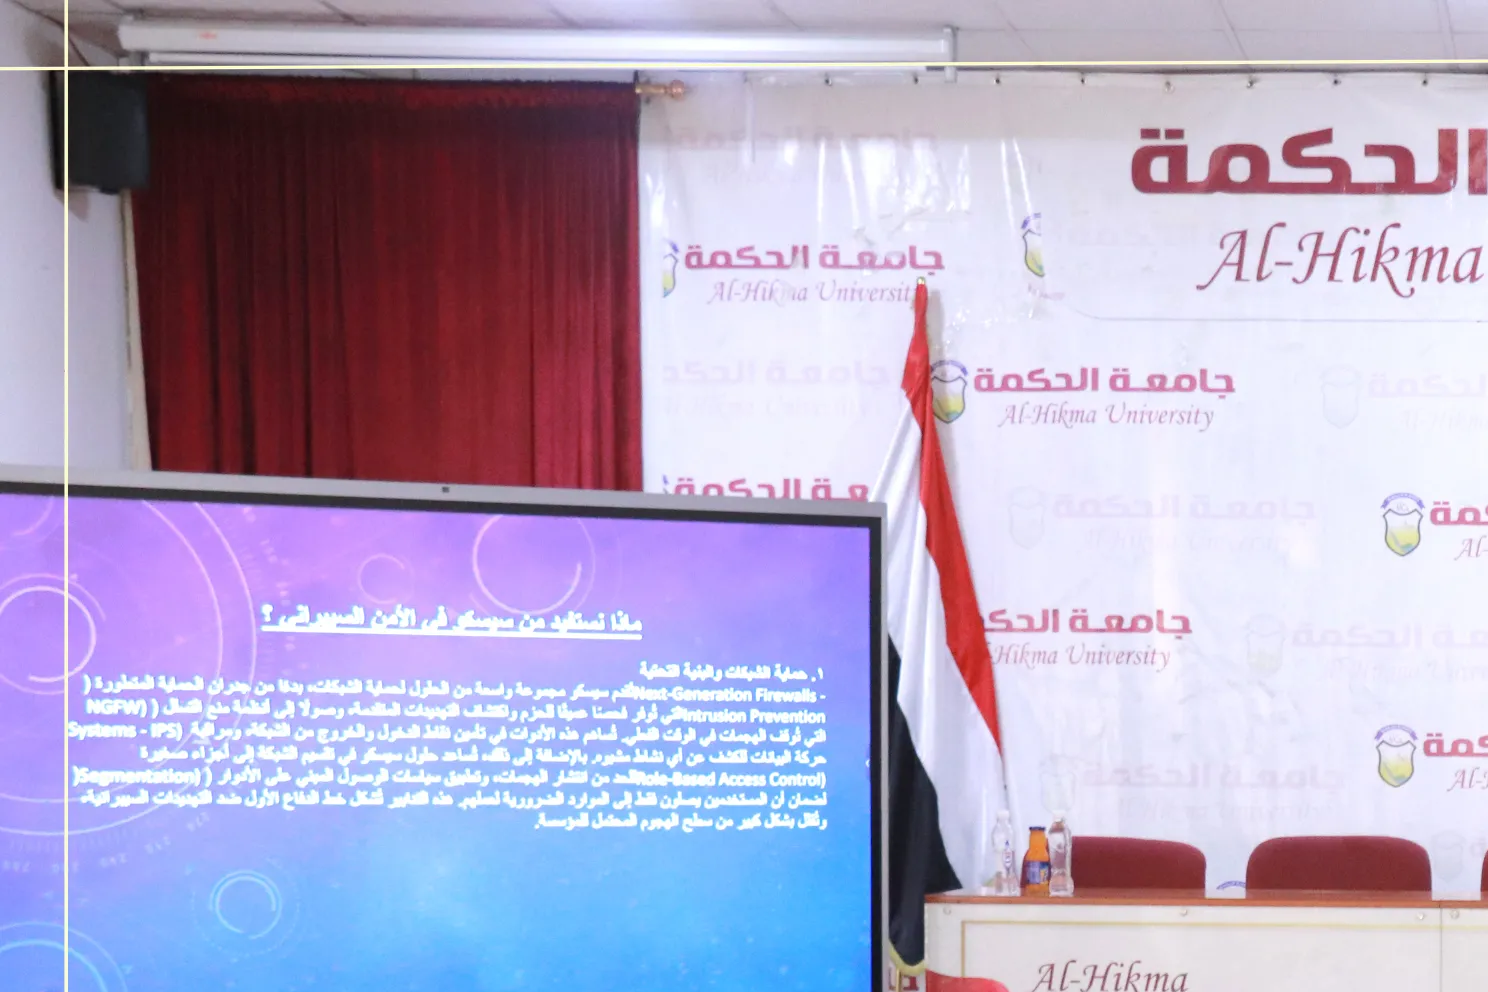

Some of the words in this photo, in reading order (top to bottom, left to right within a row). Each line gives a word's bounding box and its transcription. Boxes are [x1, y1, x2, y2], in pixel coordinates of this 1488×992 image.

[1130, 127, 1488, 196] الحكمة
[685, 245, 809, 269] الحكمة
[819, 245, 945, 276] جامعة
[1197, 222, 1483, 298] Al-Hikma
[816, 279, 914, 306] Universit
[974, 368, 1098, 391] الحكمة
[1109, 367, 1235, 398] جامعة
[998, 402, 1097, 428] Al-Hikma
[1106, 402, 1214, 432] University
[984, 609, 1059, 633] الحك
[1069, 609, 1193, 639] جامعة
[987, 639, 1059, 668] -Hikma
[1066, 639, 1171, 672] University
[750, 708, 826, 724] Prevention
[718, 772, 766, 787] Access
